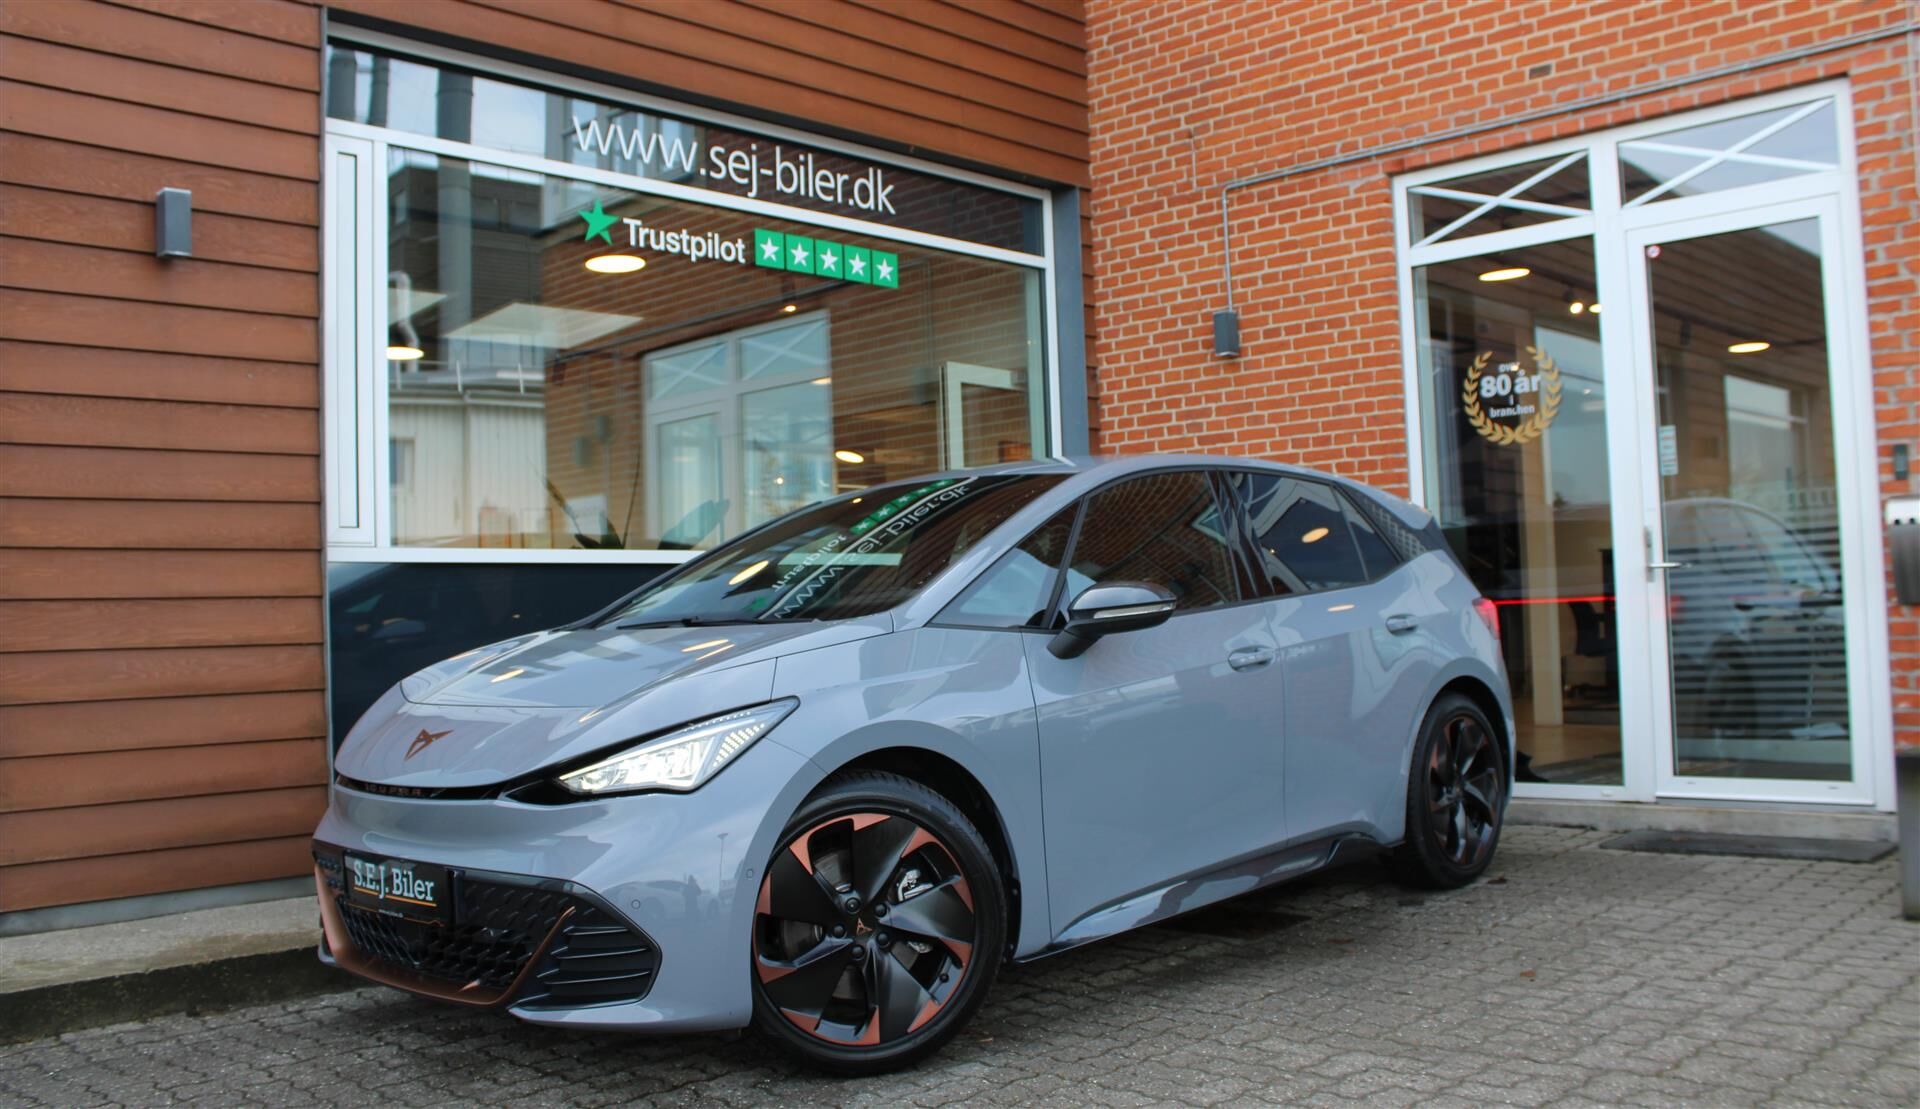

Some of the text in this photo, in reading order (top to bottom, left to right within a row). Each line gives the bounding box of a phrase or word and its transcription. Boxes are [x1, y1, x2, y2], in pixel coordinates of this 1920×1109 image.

[573, 115, 896, 215] www.sej-biler.dk
[622, 217, 746, 263] Trustpilot
[1480, 369, 1541, 398] 80 år
[1498, 362, 1520, 373] ov
[353, 859, 434, 901] S.E.J. Biler
